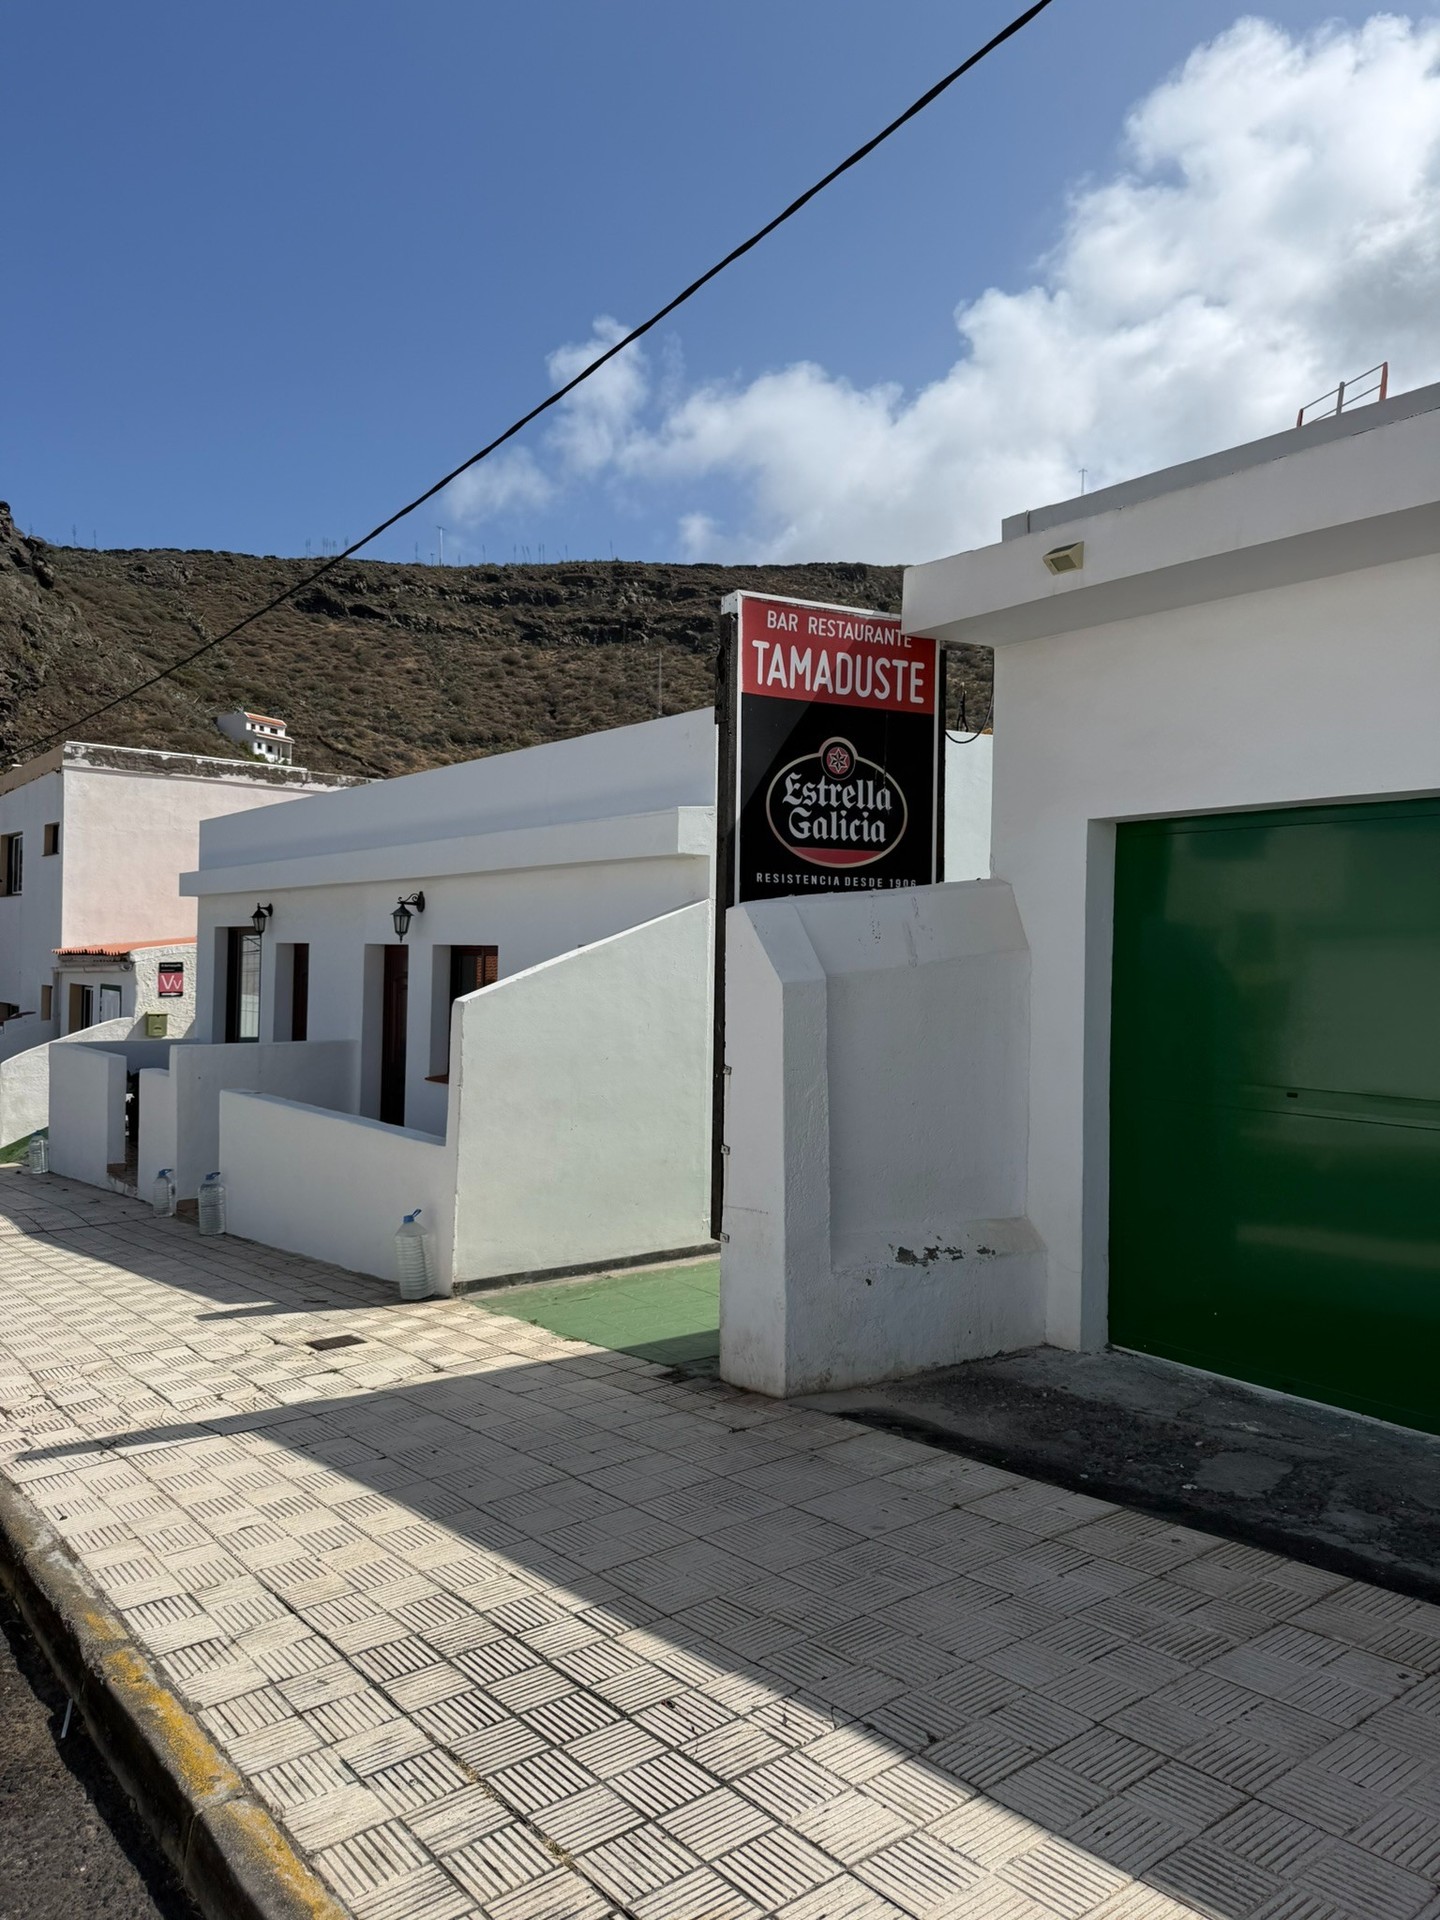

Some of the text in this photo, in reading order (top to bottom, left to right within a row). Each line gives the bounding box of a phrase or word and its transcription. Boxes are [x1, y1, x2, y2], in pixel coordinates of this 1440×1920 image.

[767, 610, 912, 648] BAR RESTAURANTE
[752, 640, 925, 703] TAMADUSTE
[782, 772, 892, 811] Estrella
[789, 807, 886, 843] Galicia
[756, 872, 916, 888] RESISTENCIA DESDE 1906
